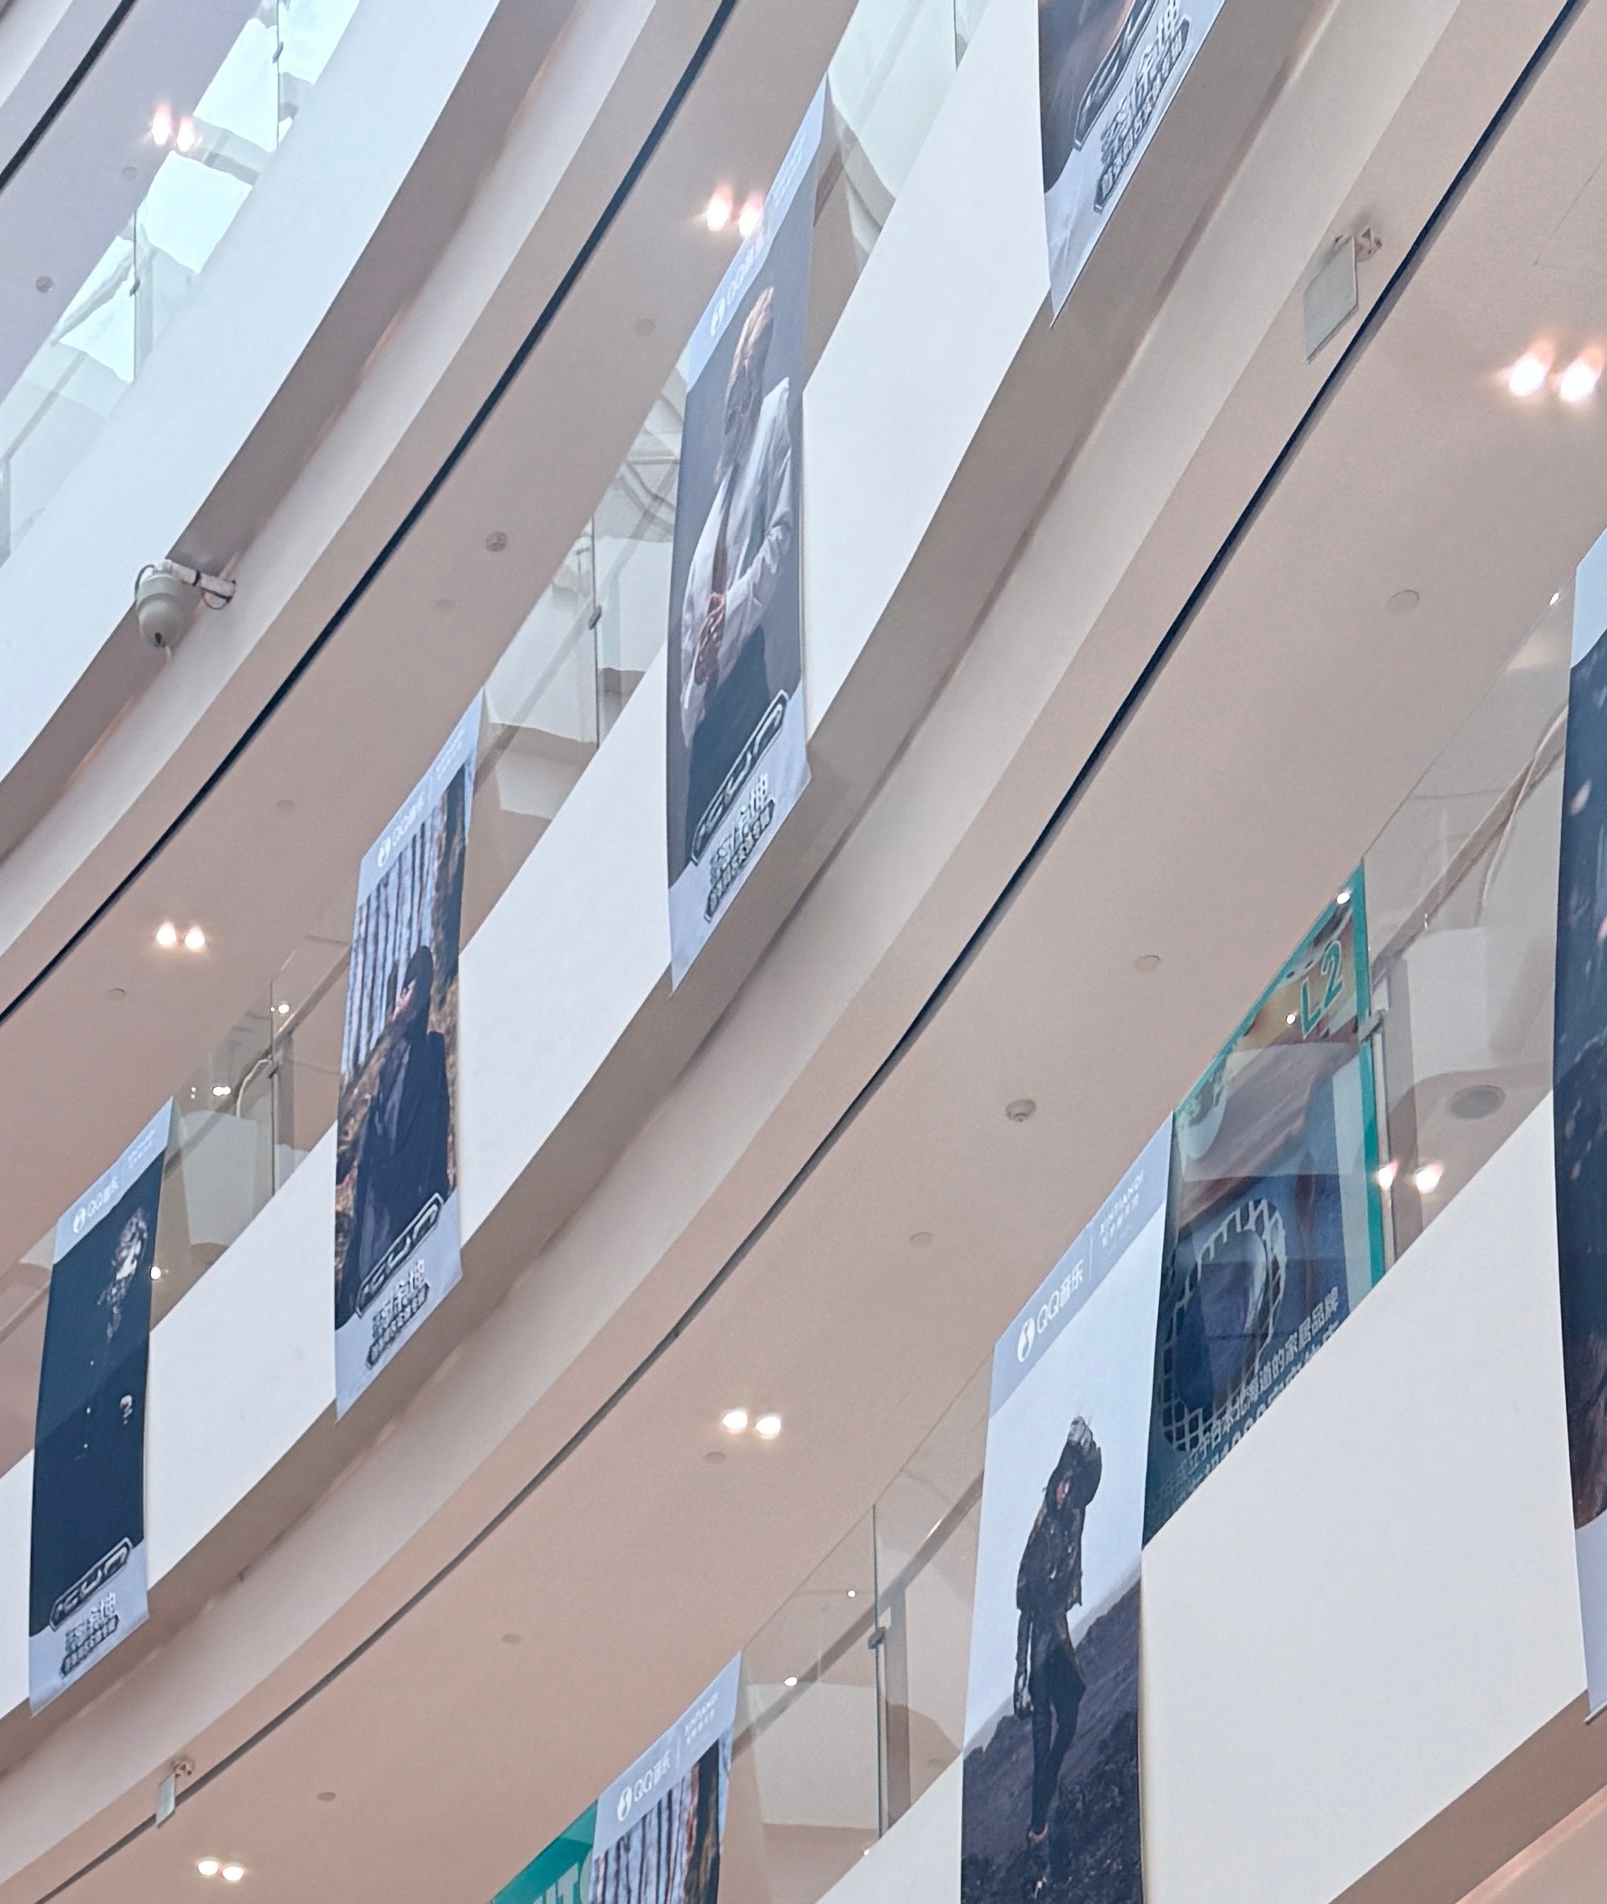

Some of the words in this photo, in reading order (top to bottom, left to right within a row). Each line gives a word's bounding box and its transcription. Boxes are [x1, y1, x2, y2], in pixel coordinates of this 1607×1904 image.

[1298, 939, 1344, 1042] L2
[1035, 1258, 1084, 1336] QQ音乐
[630, 1750, 672, 1804] QQ音乐
